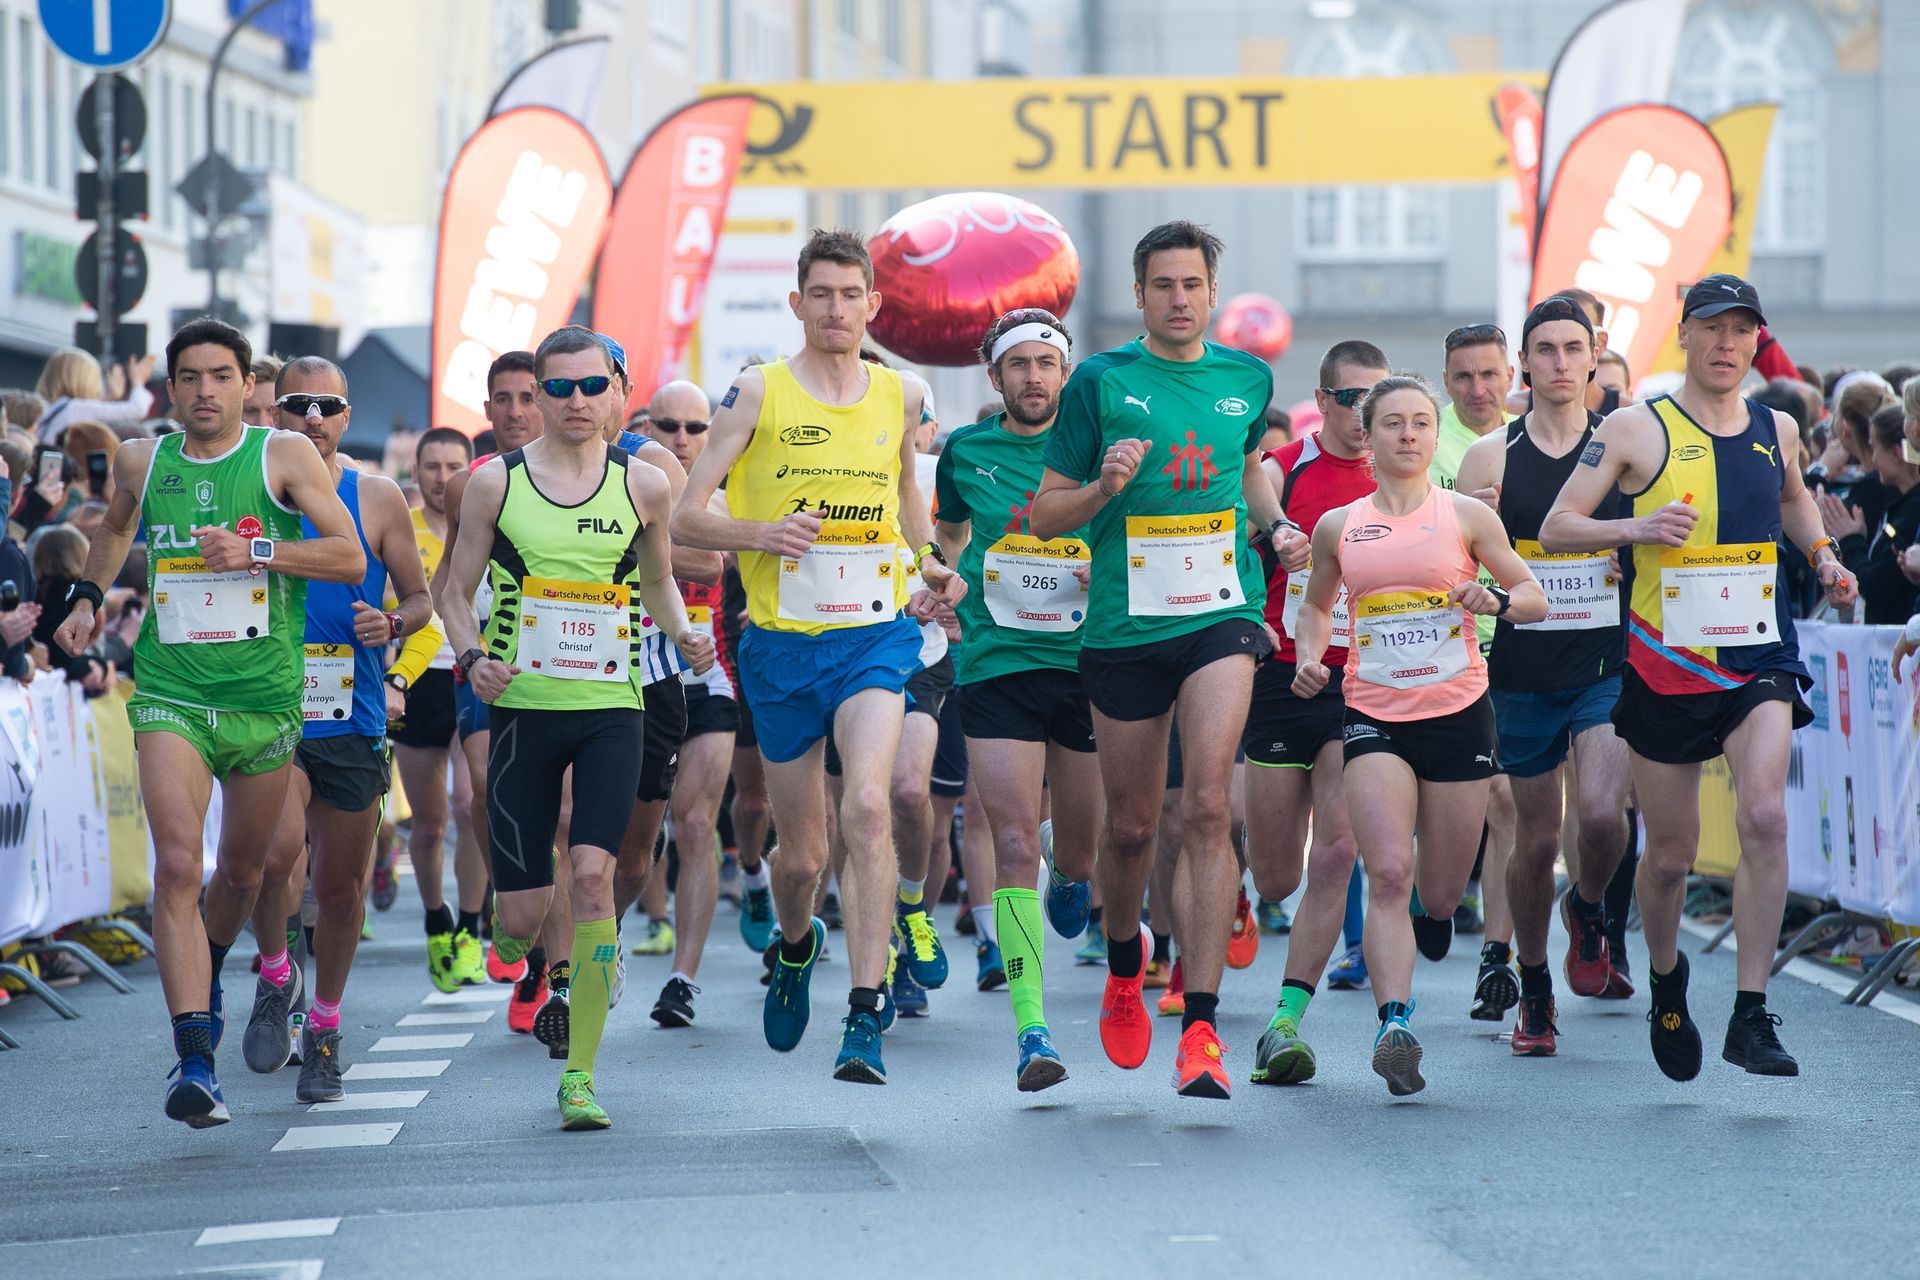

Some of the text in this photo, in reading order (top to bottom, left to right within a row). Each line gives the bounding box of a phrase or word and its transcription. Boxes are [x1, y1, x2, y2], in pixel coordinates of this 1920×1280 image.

[1013, 92, 1282, 171] START
[792, 468, 888, 480] FRONTRUNNER
[1441, 476, 1456, 489] La
[818, 500, 884, 522] bunert
[577, 518, 623, 534] FILA
[1147, 526, 1186, 534] Deutsche
[1005, 544, 1041, 554] Deutsche
[1184, 556, 1193, 570] 5
[1683, 556, 1723, 564] Deutsche
[838, 566, 844, 579] 1
[1022, 575, 1058, 590] 9265
[205, 592, 213, 606] 2
[583, 593, 600, 601] Post
[1172, 593, 1211, 604] BAUHAUS
[1578, 593, 1614, 604] Bornheim
[1720, 587, 1730, 600] 4
[1368, 603, 1405, 613] Deutsche
[1022, 612, 1061, 620] BAUHAUS
[1332, 611, 1348, 620] Alex
[561, 620, 595, 636] 1185
[1709, 626, 1748, 634] BAUHAUS
[1381, 628, 1438, 647] 11922-1
[558, 642, 592, 652] Christof
[559, 659, 597, 669] BAUHAUS
[1398, 666, 1438, 677] BAUHAUS
[307, 695, 335, 703] Arroyo
[1009, 971, 1023, 980] cep
